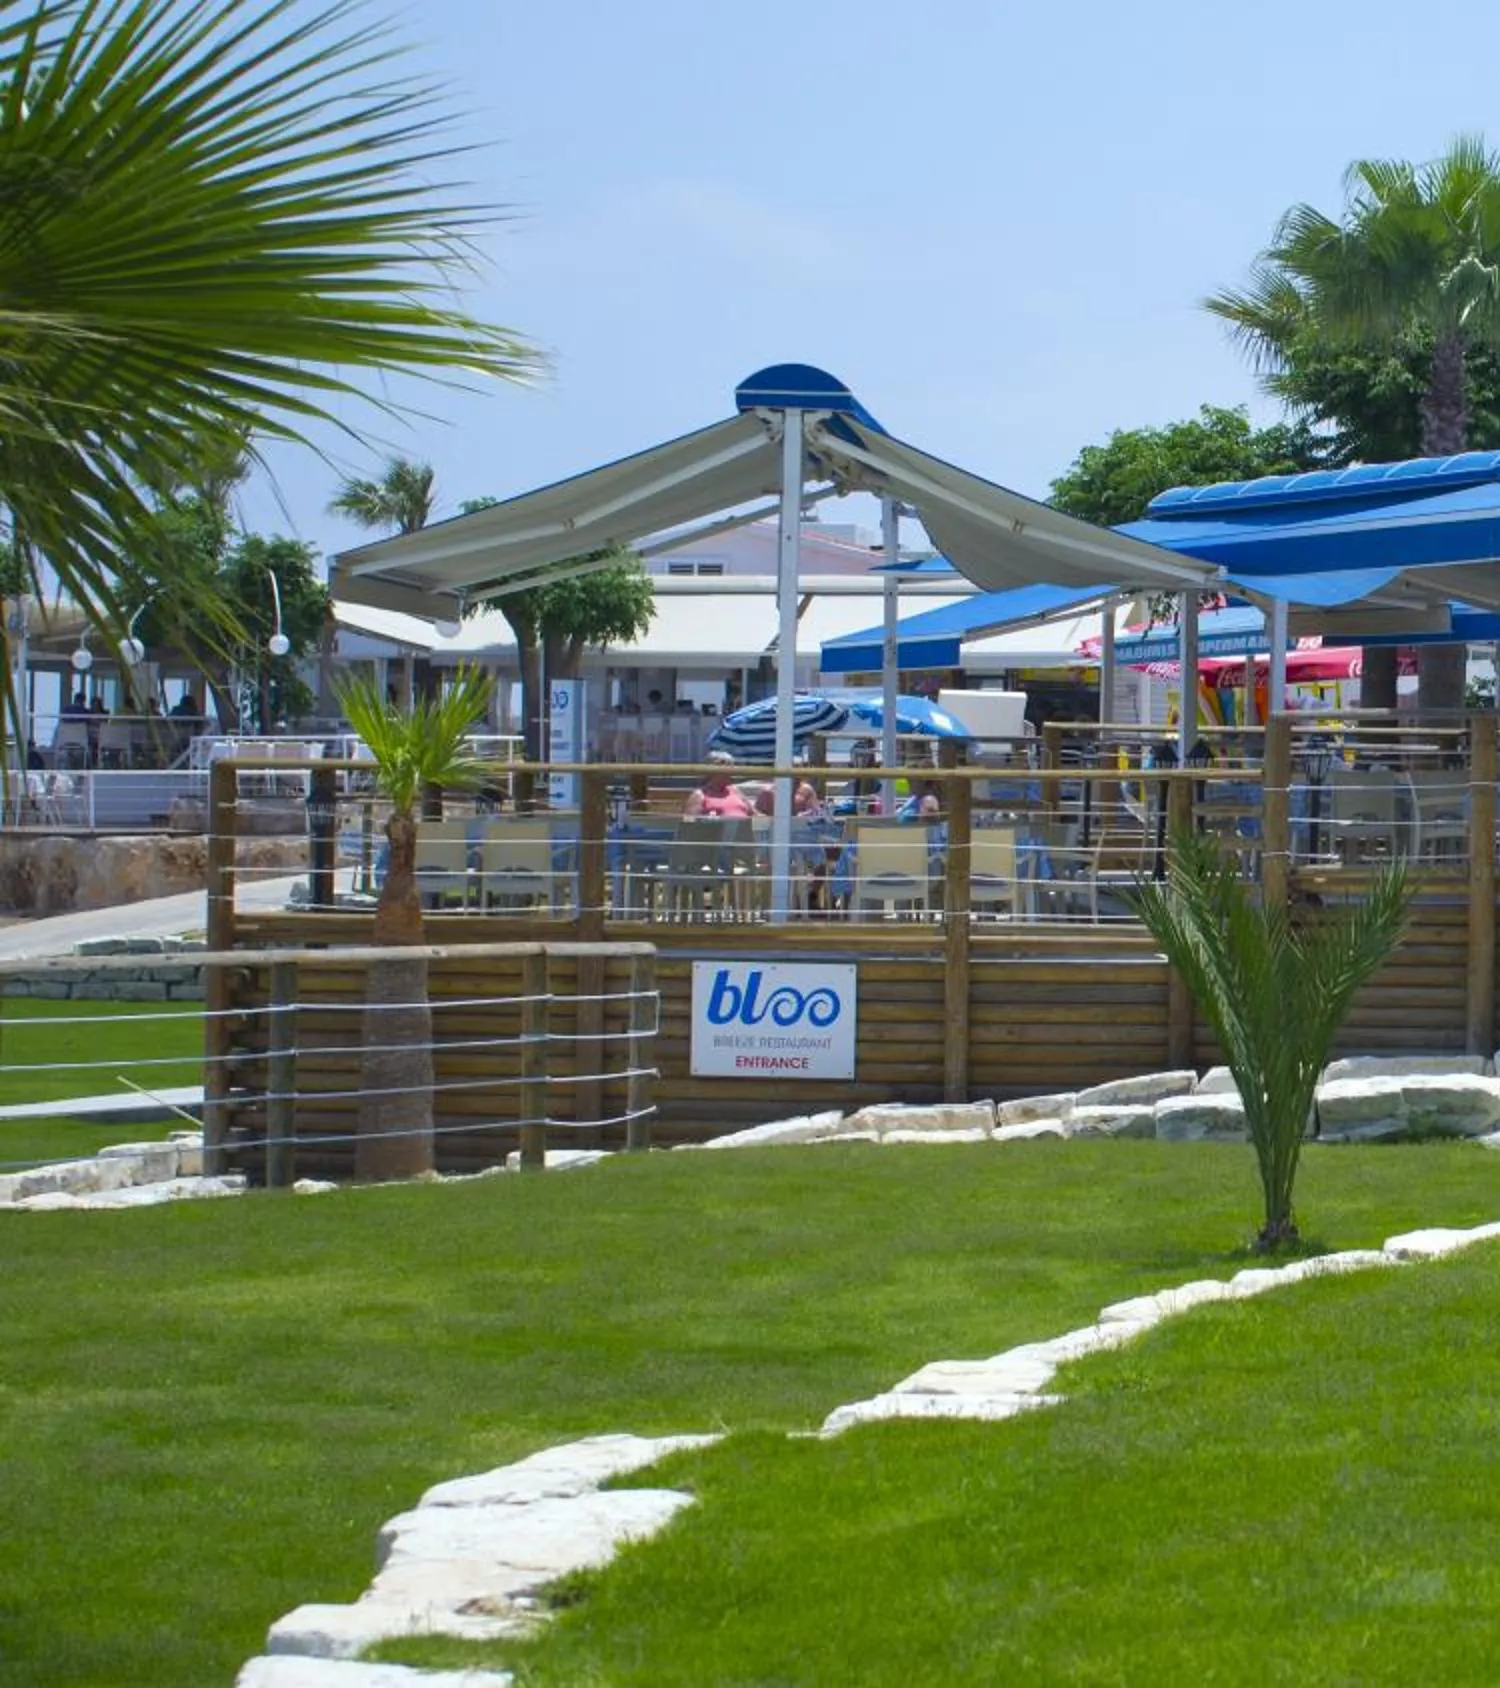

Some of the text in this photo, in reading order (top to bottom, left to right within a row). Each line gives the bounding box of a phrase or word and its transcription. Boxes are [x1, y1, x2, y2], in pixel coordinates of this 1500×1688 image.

[707, 970, 841, 1027] bloo
[713, 1035, 832, 1050] BREEZE RESTAURANT
[735, 1055, 809, 1069] ENTRANCE
